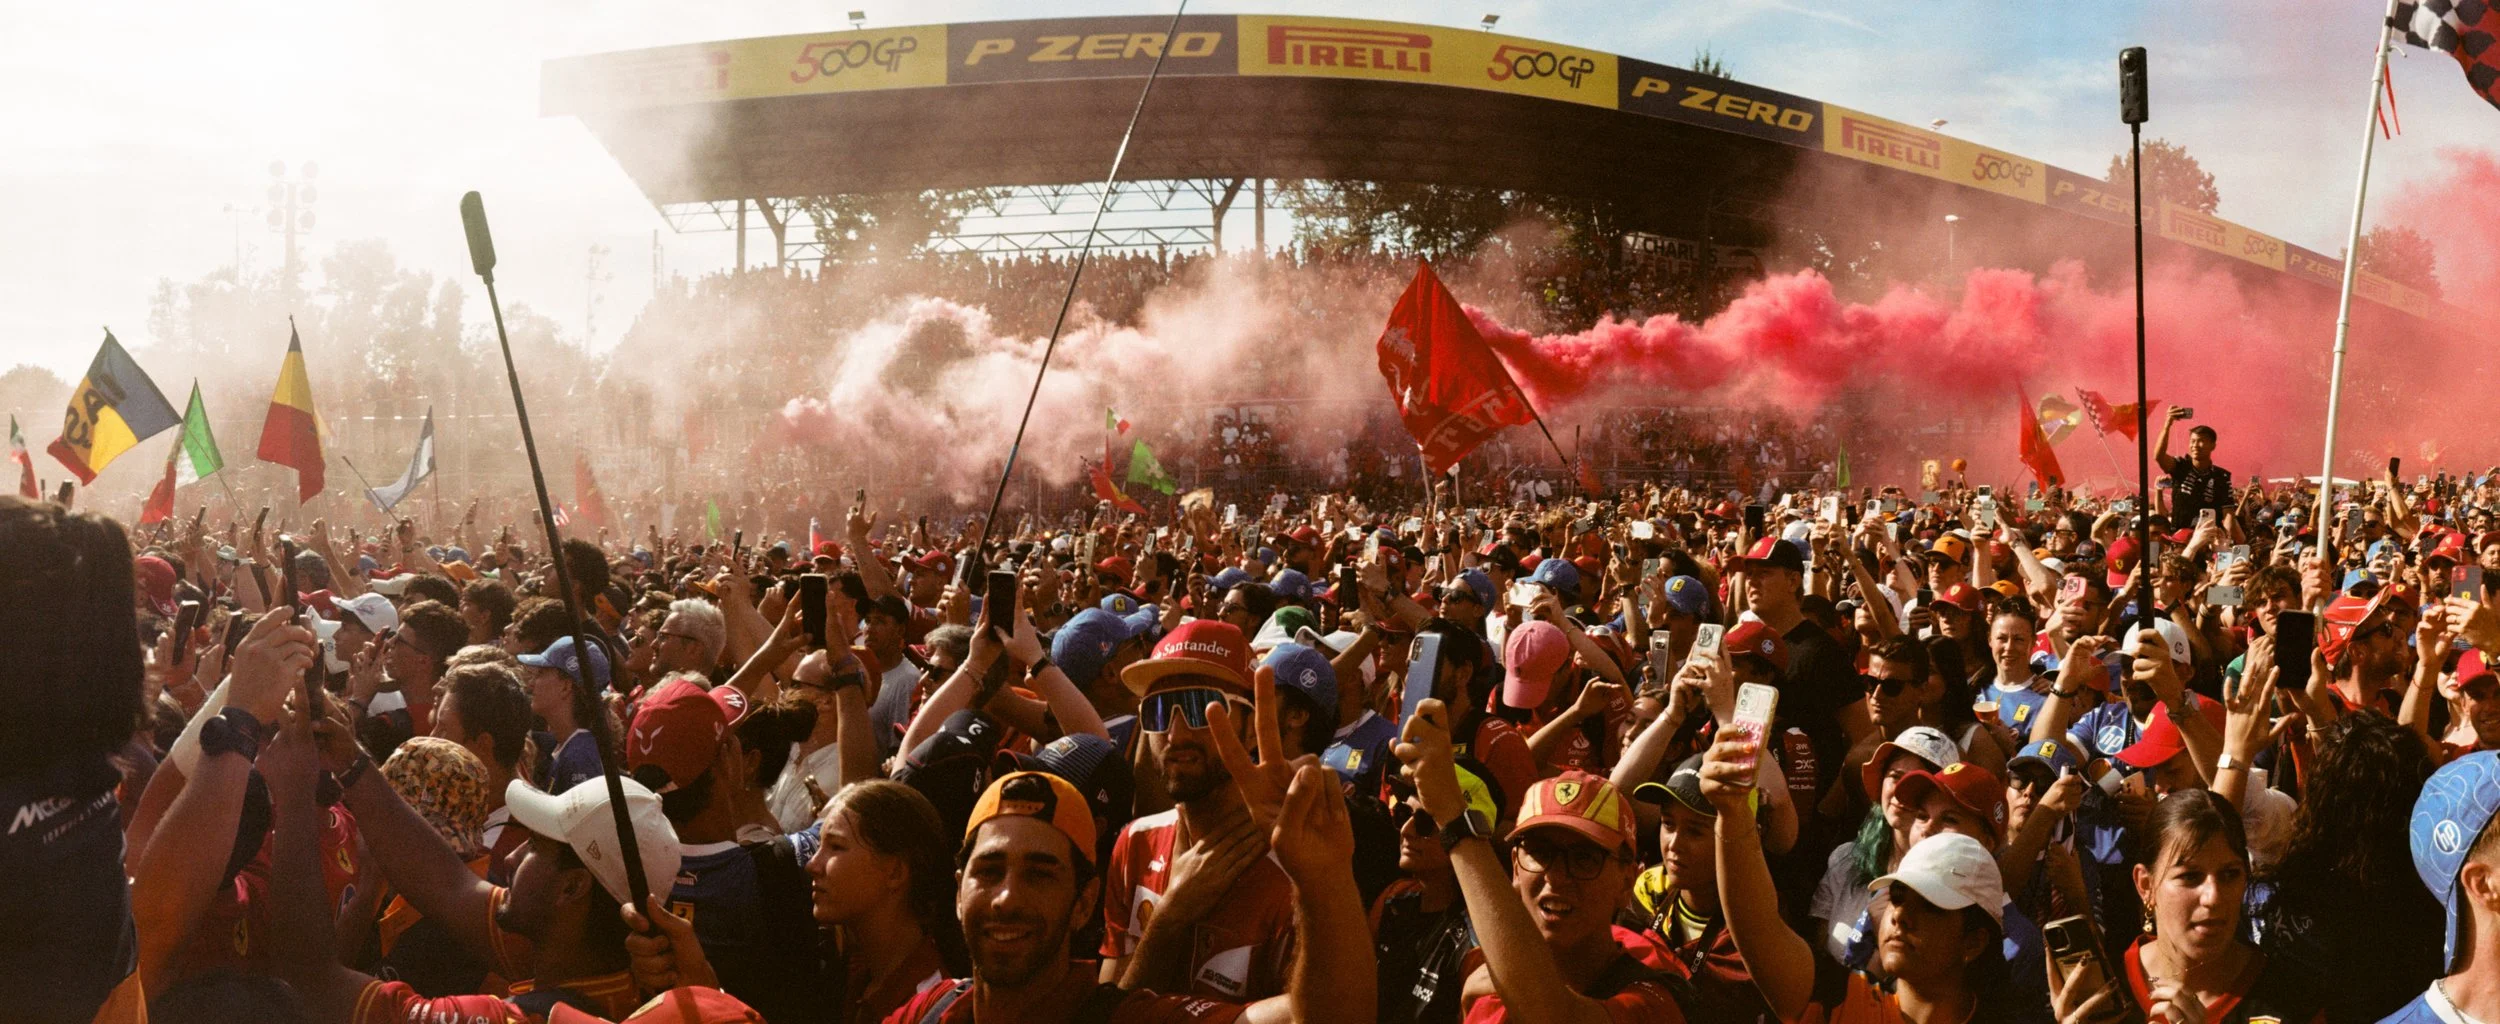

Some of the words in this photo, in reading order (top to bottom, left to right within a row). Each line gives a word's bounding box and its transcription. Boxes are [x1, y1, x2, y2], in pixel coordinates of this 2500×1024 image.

[964, 39, 1015, 65] P
[1028, 31, 1223, 62] ZERO
[1267, 25, 1433, 74] PIRELLI
[1632, 76, 1671, 98] P
[1679, 86, 1814, 132] ZERO
[1841, 116, 1942, 170] PIRELLI
[2053, 180, 2076, 197] P
[1644, 236, 1718, 264] CHARLS
[2289, 252, 2302, 266] P
[1163, 640, 1231, 658] Santander
[1300, 668, 1318, 688] hp
[2096, 725, 2125, 755] hp
[2434, 820, 2461, 854] hp
[1691, 950, 1704, 973] EOS
